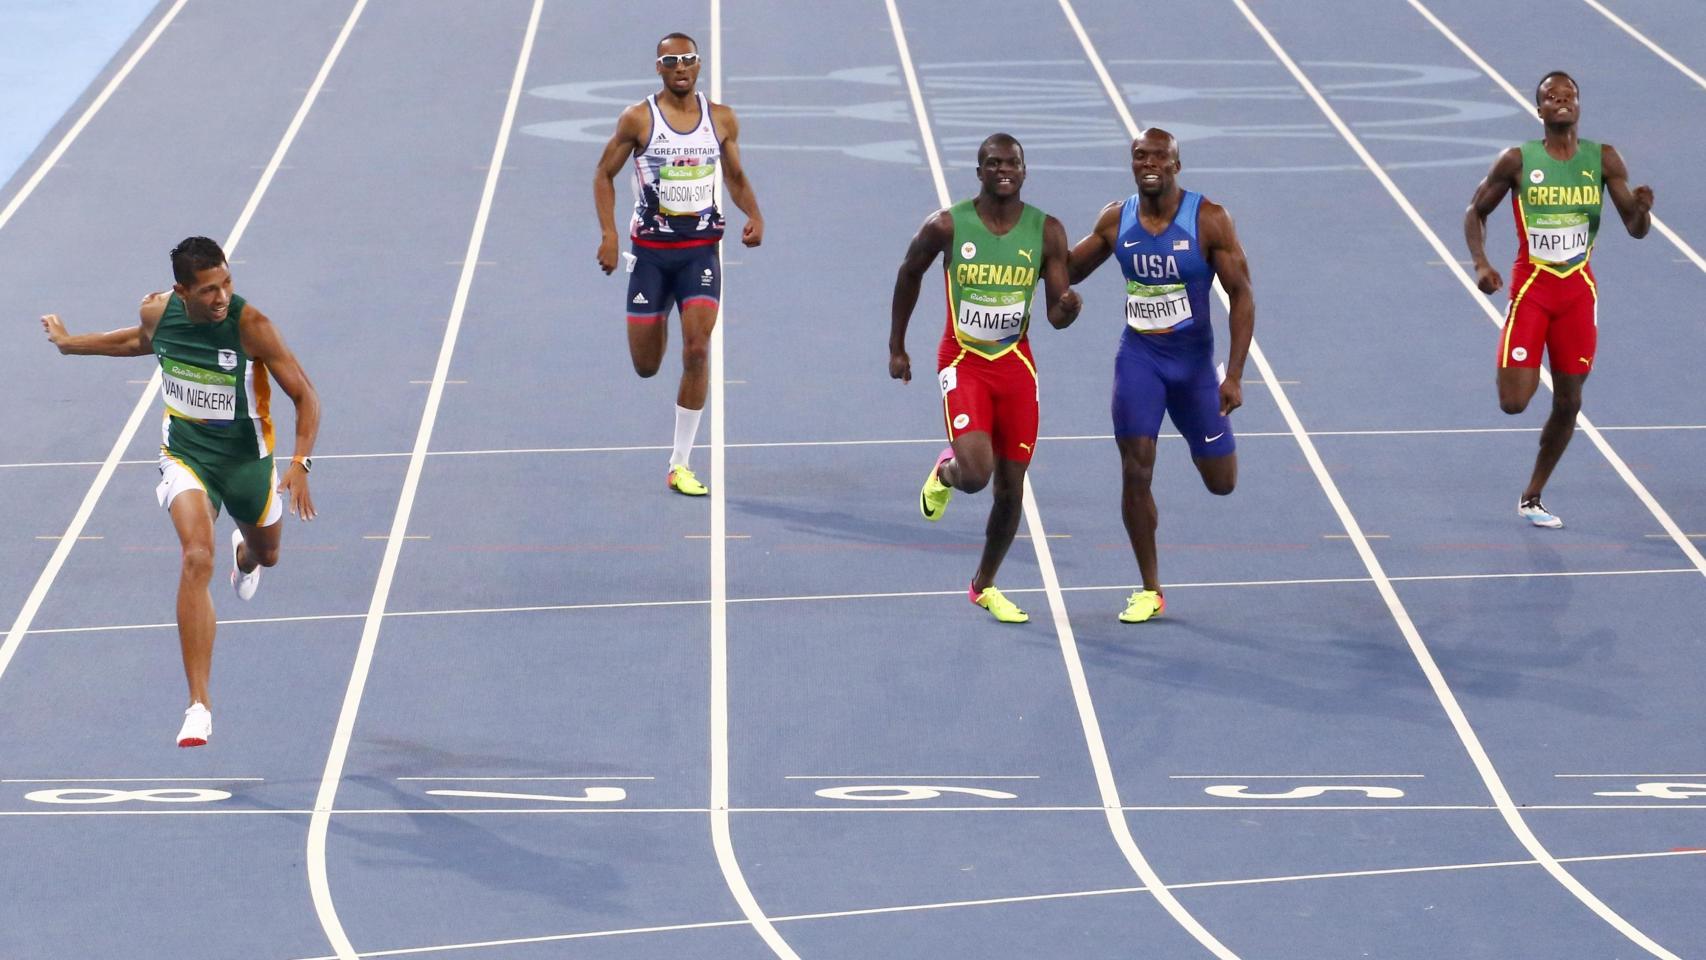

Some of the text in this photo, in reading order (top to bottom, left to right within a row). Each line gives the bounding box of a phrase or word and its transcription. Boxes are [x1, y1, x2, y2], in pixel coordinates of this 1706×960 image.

[654, 147, 715, 155] GREAT BRITAIN
[660, 184, 713, 202] HUDSON-SM
[1528, 185, 1600, 205] GRENADA
[1530, 231, 1587, 250] TAPLIN
[957, 263, 1034, 286] GRENADA
[1132, 253, 1180, 280] USA
[1128, 296, 1187, 319] MERRITT
[960, 309, 1021, 330] JAMES
[942, 374, 949, 390] 6
[164, 379, 234, 411] VAN NIEKERK
[24, 788, 233, 804] 8
[426, 787, 627, 802] 7
[815, 785, 1018, 801] 6
[1205, 784, 1405, 800] 5
